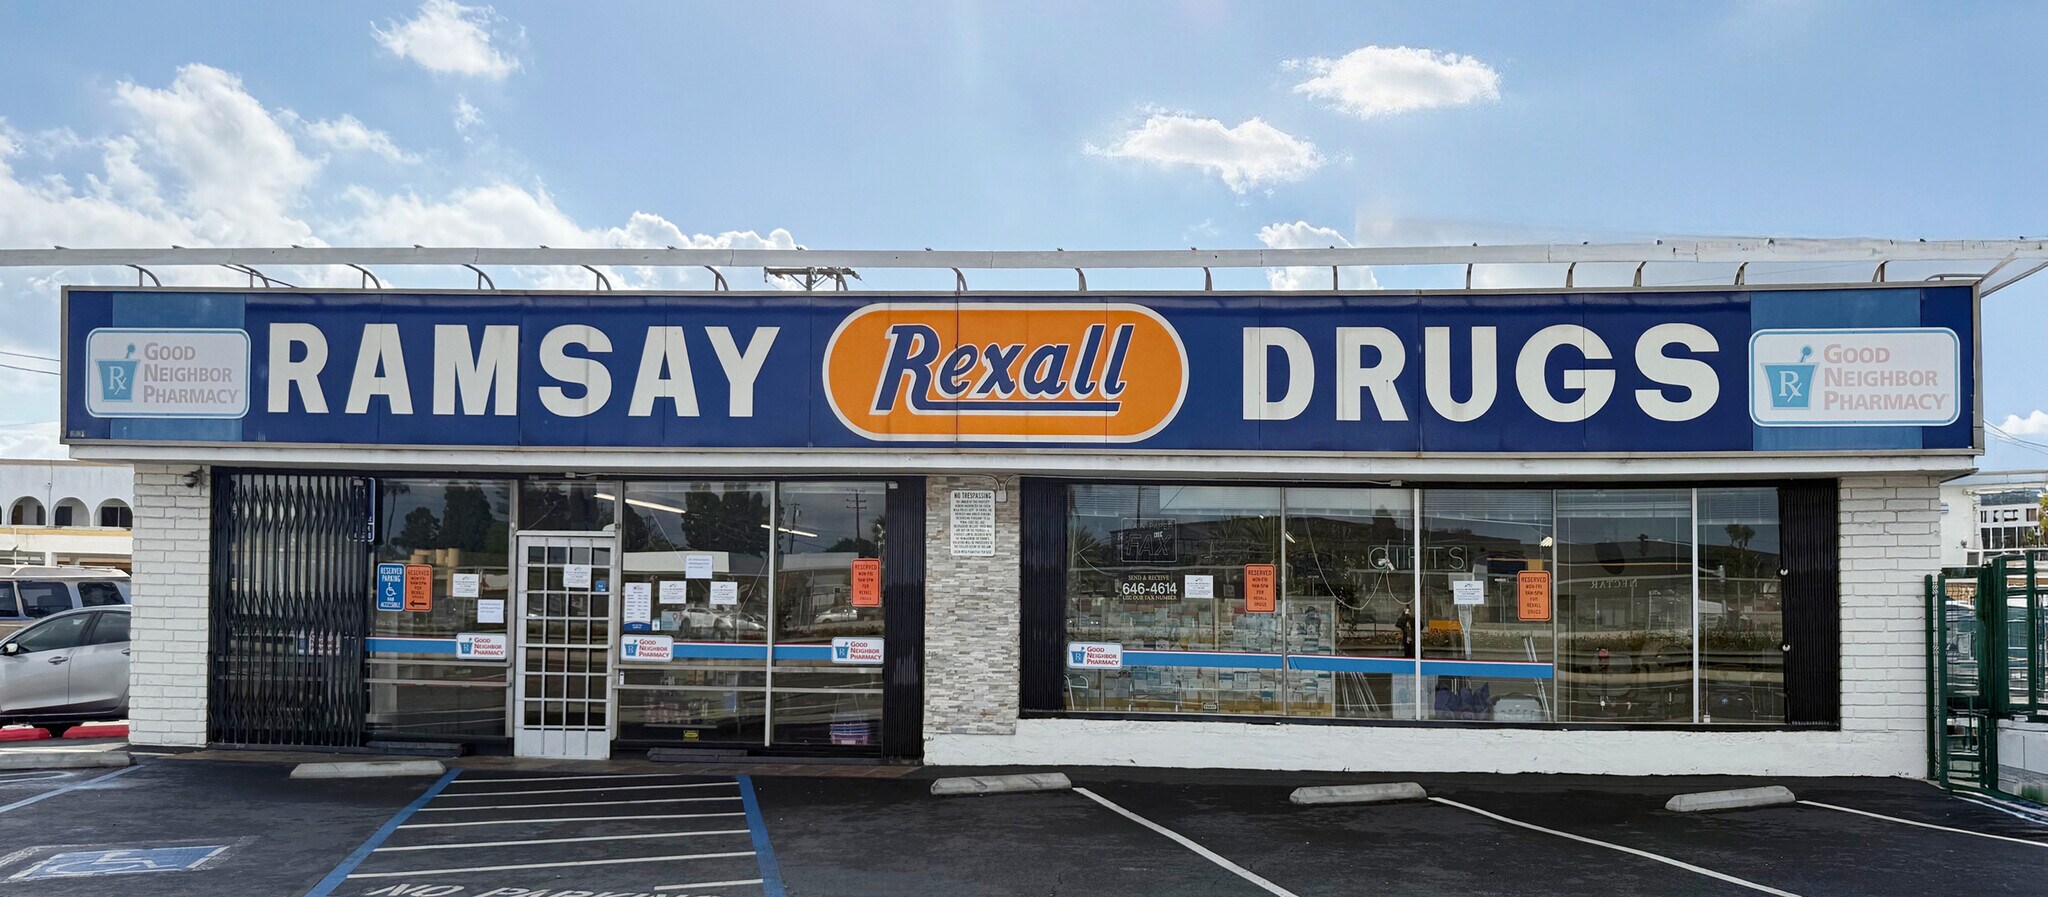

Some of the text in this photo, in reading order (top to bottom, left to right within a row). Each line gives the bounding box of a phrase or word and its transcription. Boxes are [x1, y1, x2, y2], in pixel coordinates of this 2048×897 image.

[144, 342, 196, 361] GOOD
[1824, 343, 1890, 364] GOOD
[144, 363, 233, 382] NEIGHBOR
[267, 322, 1720, 422] RAMSAY Rexall DRUGS
[1824, 367, 1938, 387] NEIGHBOR
[144, 384, 237, 404] PHARMACY
[1824, 390, 1946, 410] PHARMACY
[1125, 533, 1170, 556] FAX
[1370, 546, 1464, 570] GIFTS
[380, 567, 403, 575] RESERVED
[1122, 582, 1177, 594] 646-4614
[365, 884, 465, 897] NO
